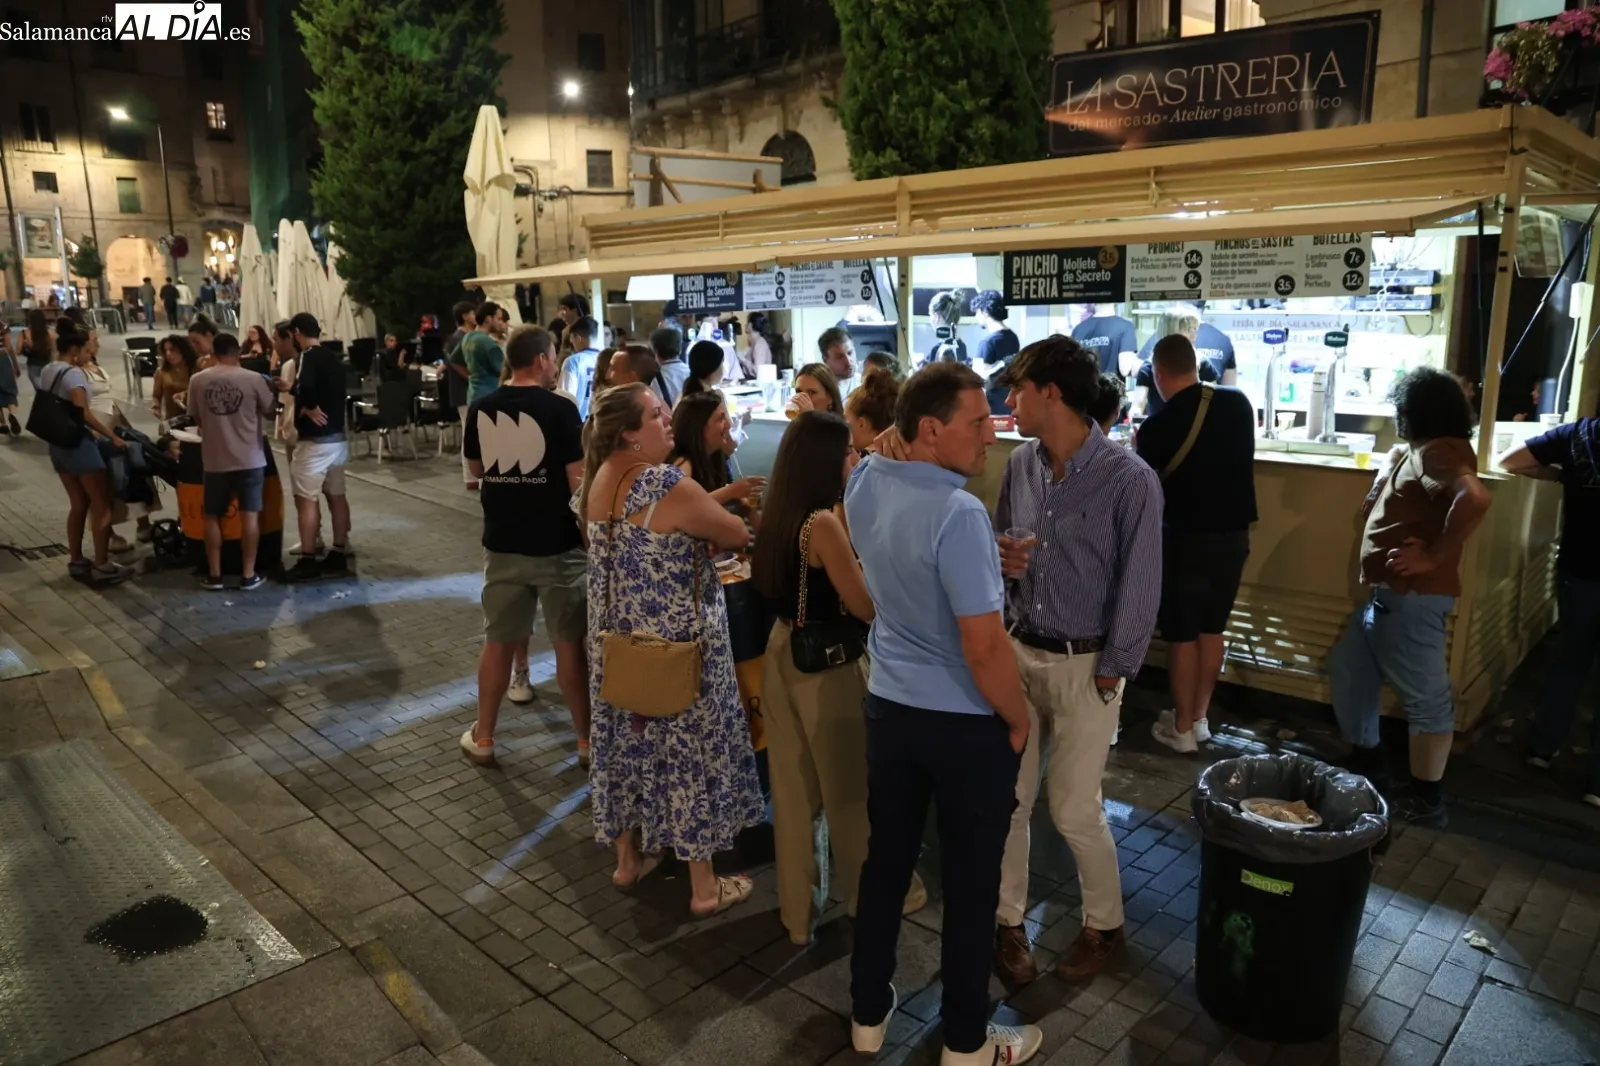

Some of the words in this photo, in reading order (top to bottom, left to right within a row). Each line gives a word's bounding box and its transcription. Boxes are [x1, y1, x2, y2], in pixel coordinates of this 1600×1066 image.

[1066, 77, 1101, 115] LA
[1113, 50, 1346, 111] SASTRERIA
[1068, 117, 1091, 132] del
[1096, 113, 1161, 129] mercado
[1169, 107, 1222, 123] Atelier
[1223, 96, 1343, 121] gastronómico
[1012, 254, 1059, 276] PINCHO
[1063, 257, 1096, 270] Mollete
[677, 275, 704, 292] PINCHO
[1062, 271, 1074, 283] de
[1075, 269, 1111, 282] Secreto
[1021, 277, 1059, 299] FERIA
[683, 292, 705, 309] FERIA
[521, 476, 547, 484] RADIO
